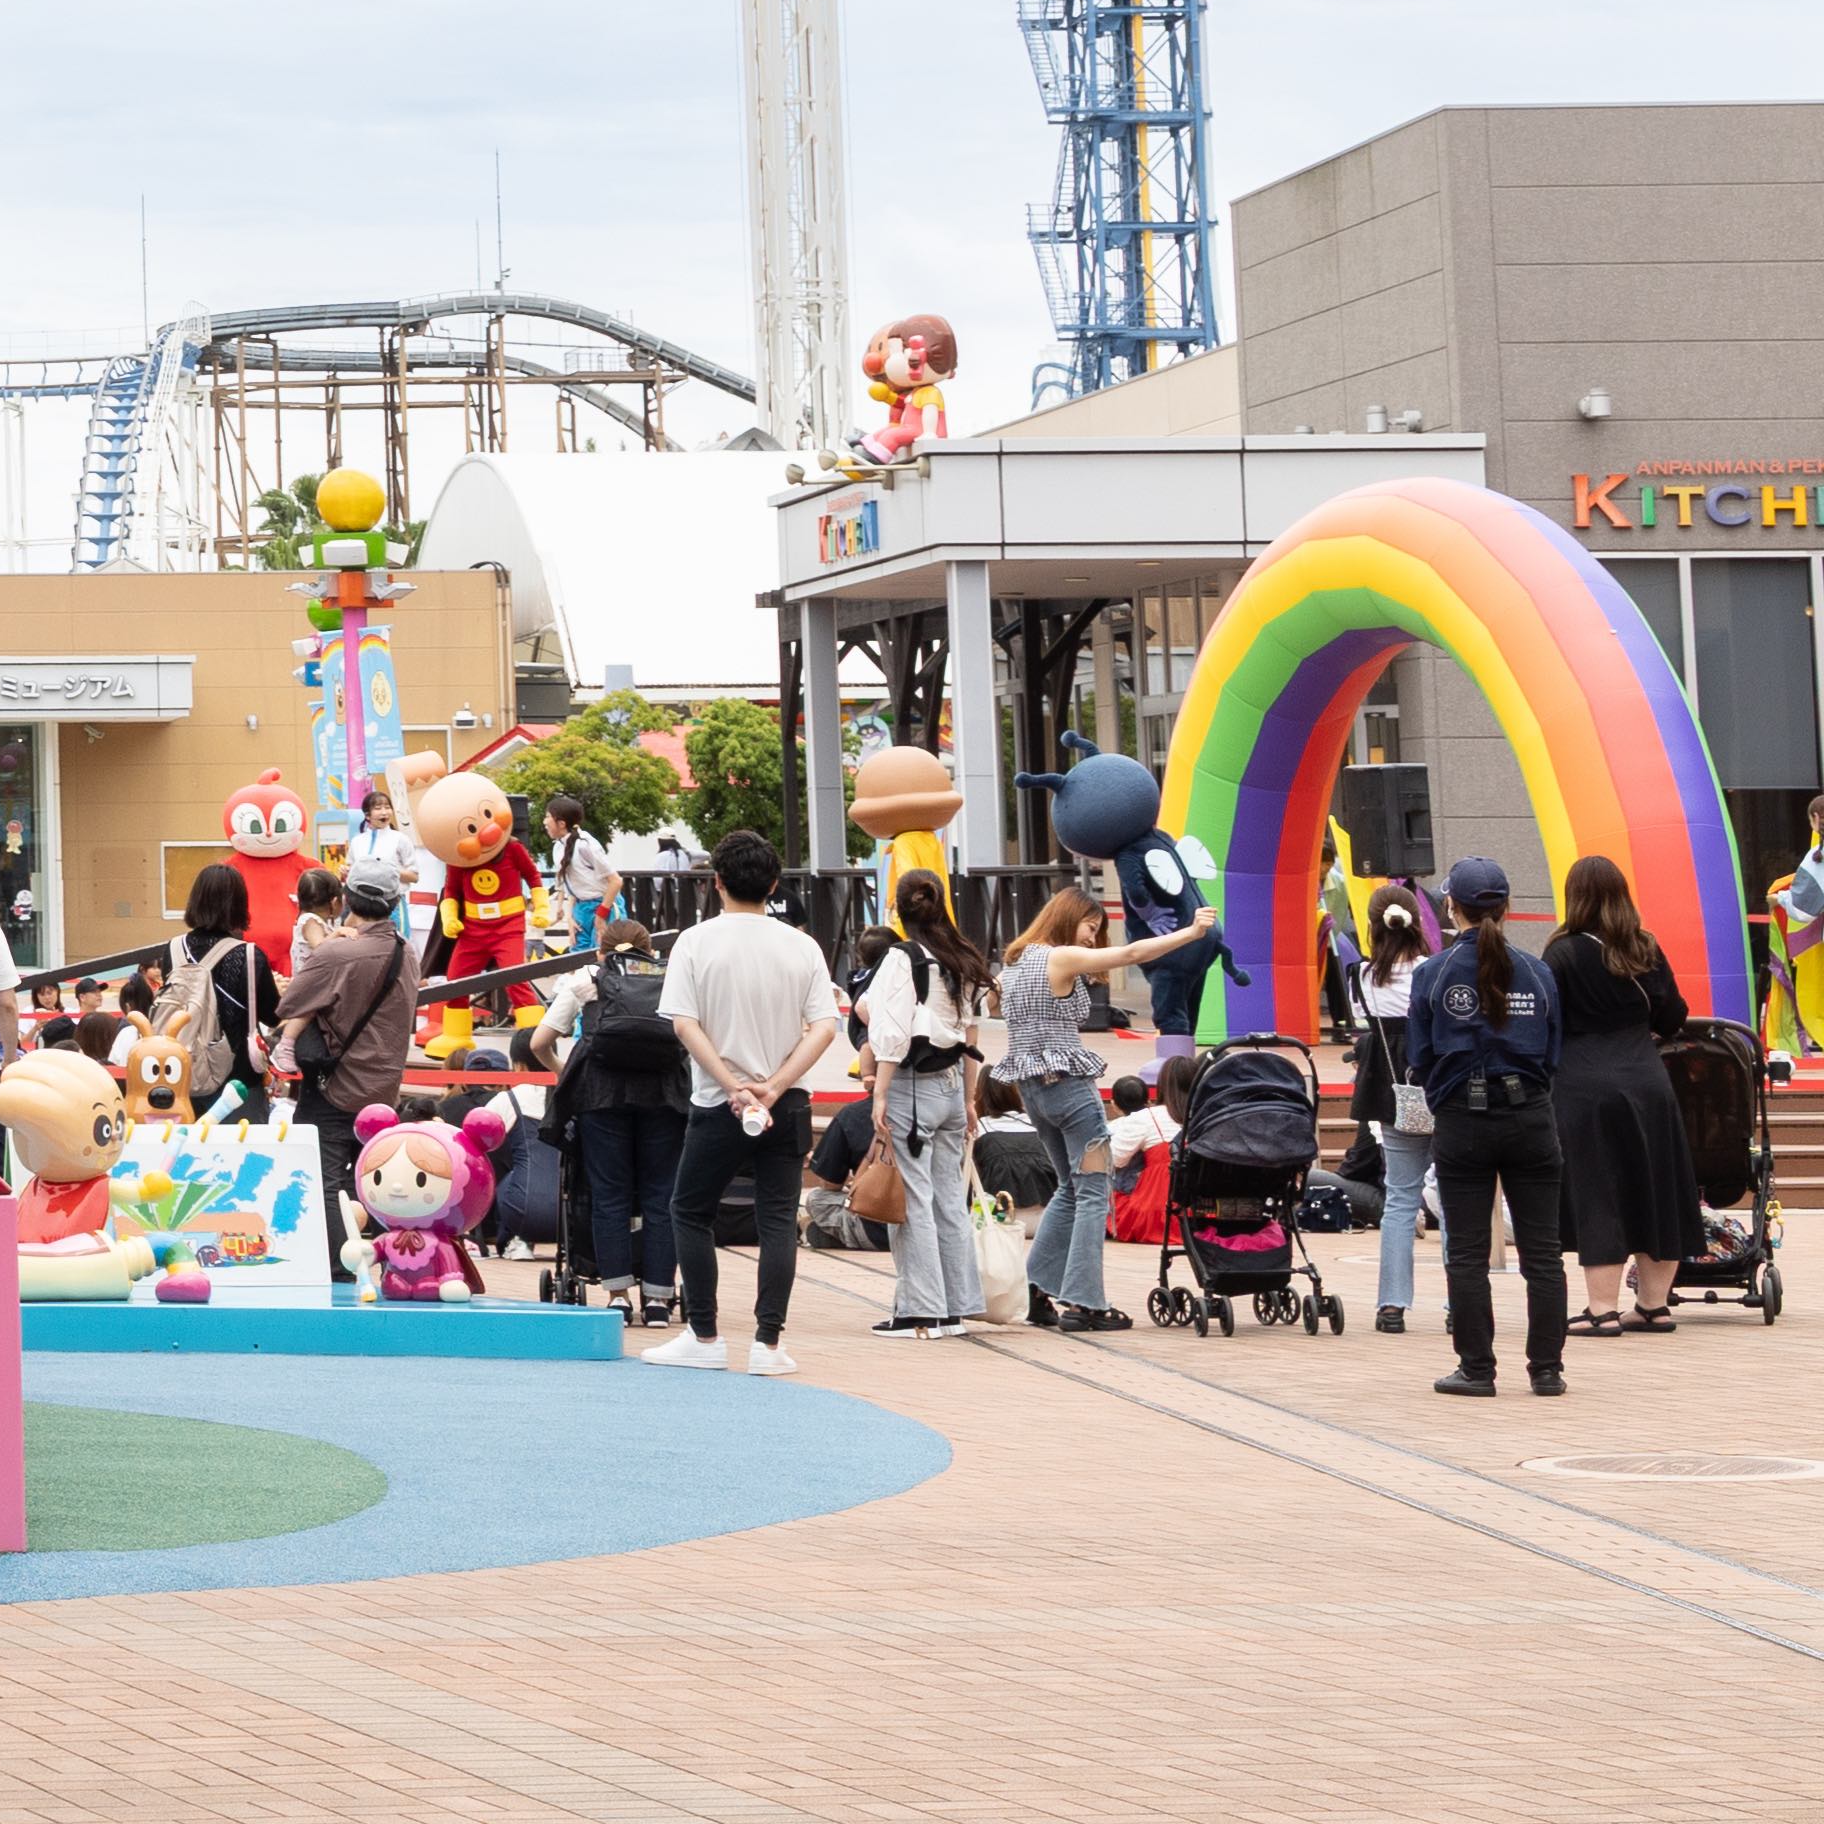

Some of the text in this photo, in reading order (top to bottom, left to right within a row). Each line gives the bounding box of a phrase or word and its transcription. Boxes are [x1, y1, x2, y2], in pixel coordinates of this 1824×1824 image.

[1636, 459, 1765, 475] ANPANMAN
[1768, 459, 1784, 474] &
[1, 674, 135, 700] ミュージアム
